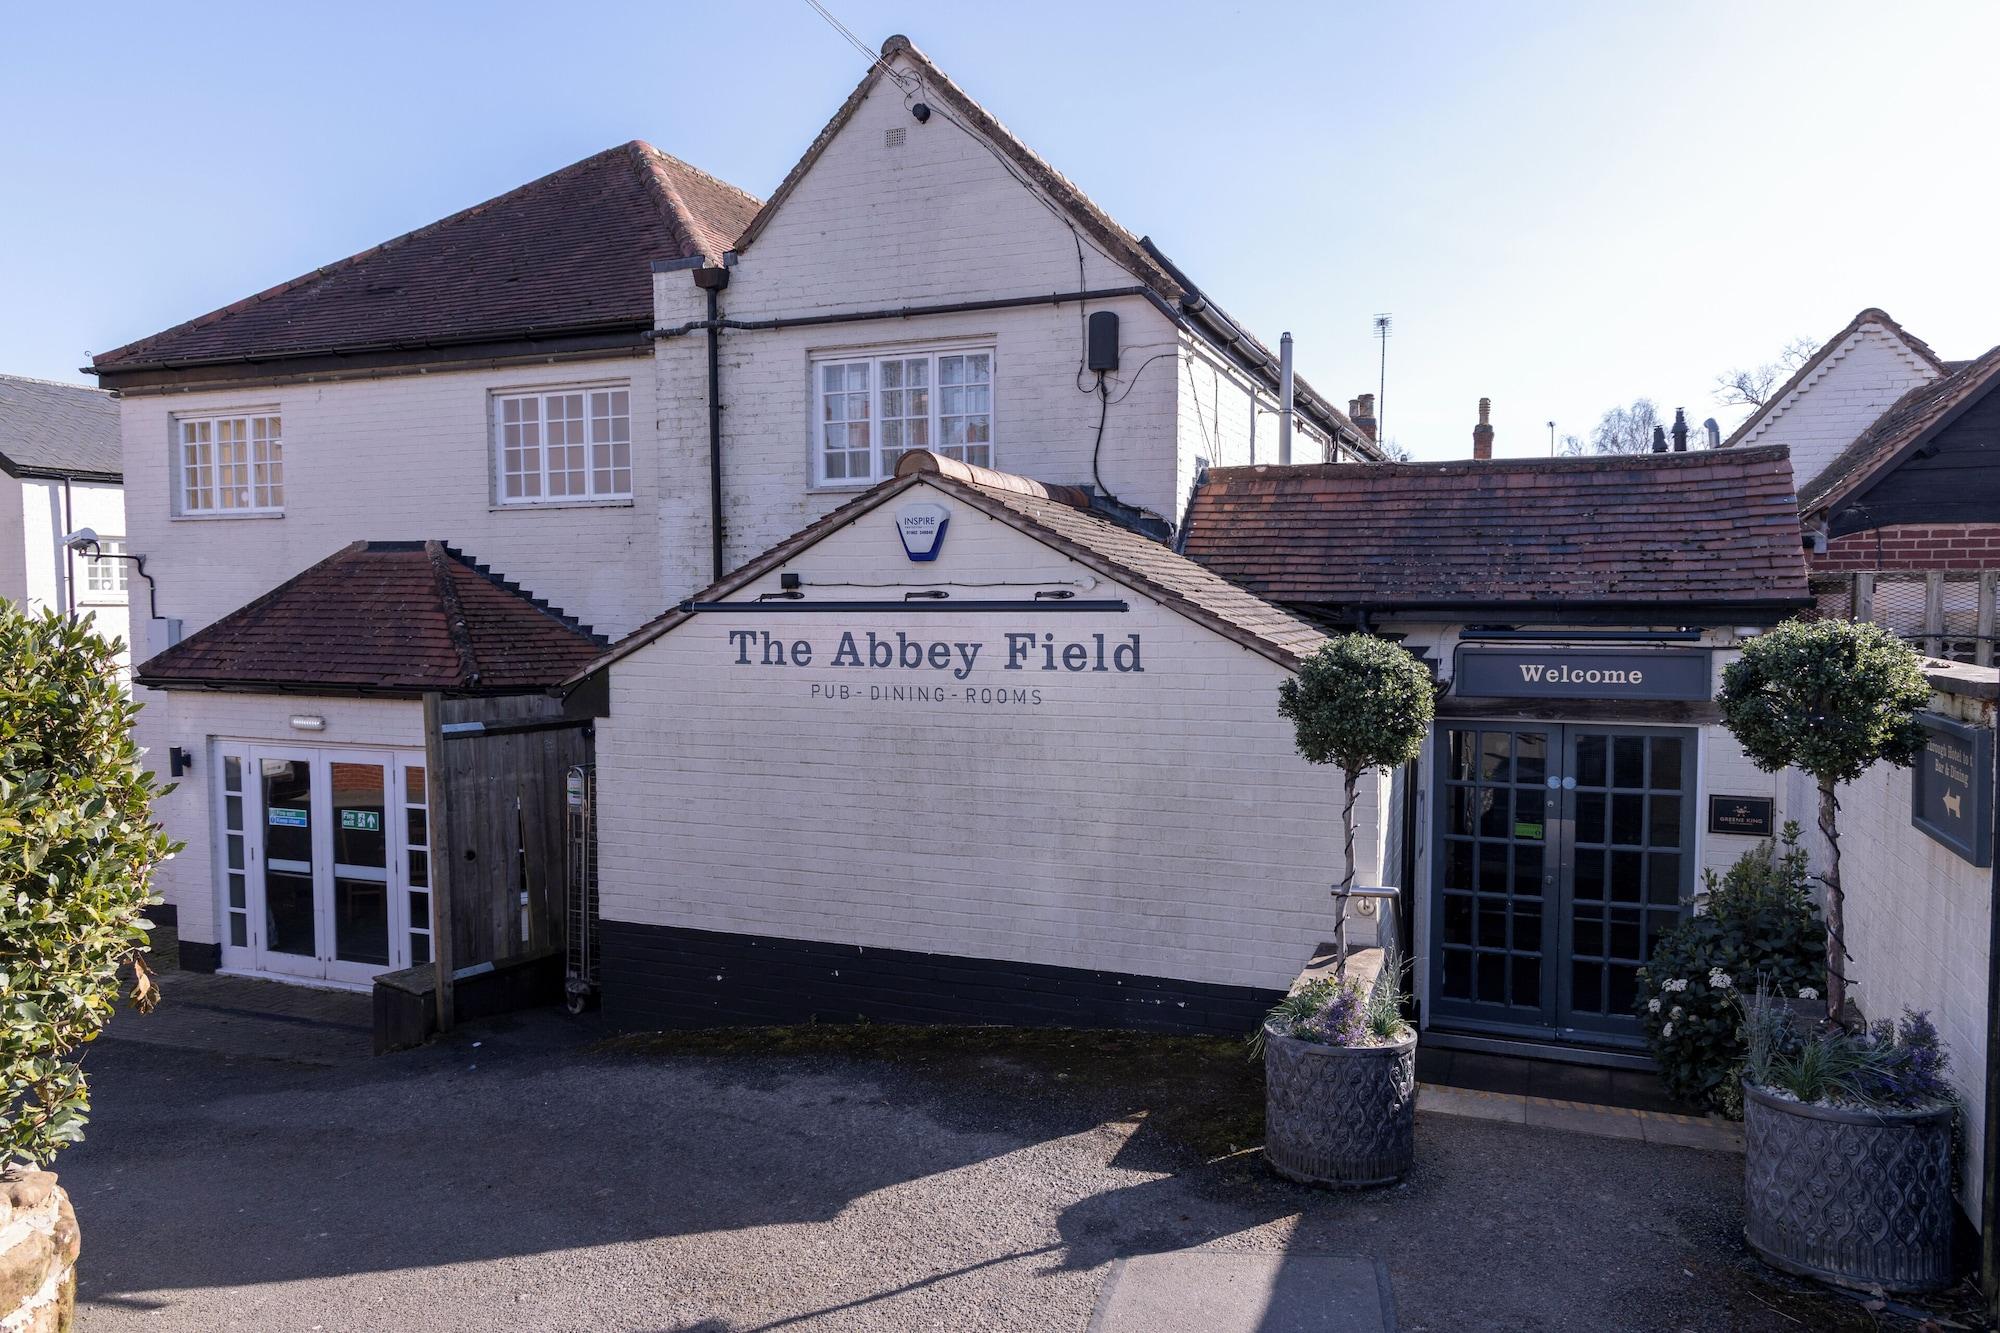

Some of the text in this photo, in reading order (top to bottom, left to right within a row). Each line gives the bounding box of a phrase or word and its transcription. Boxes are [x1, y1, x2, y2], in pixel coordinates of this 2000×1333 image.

[904, 516, 934, 525] INSPIRE
[729, 630, 1145, 680] The Abbey Field
[1519, 664, 1643, 684] Welcome
[1948, 746, 1962, 762] Hotel
[1935, 758, 1944, 774] Bar
[1950, 765, 1968, 788] Dining
[343, 811, 355, 819] Fire
